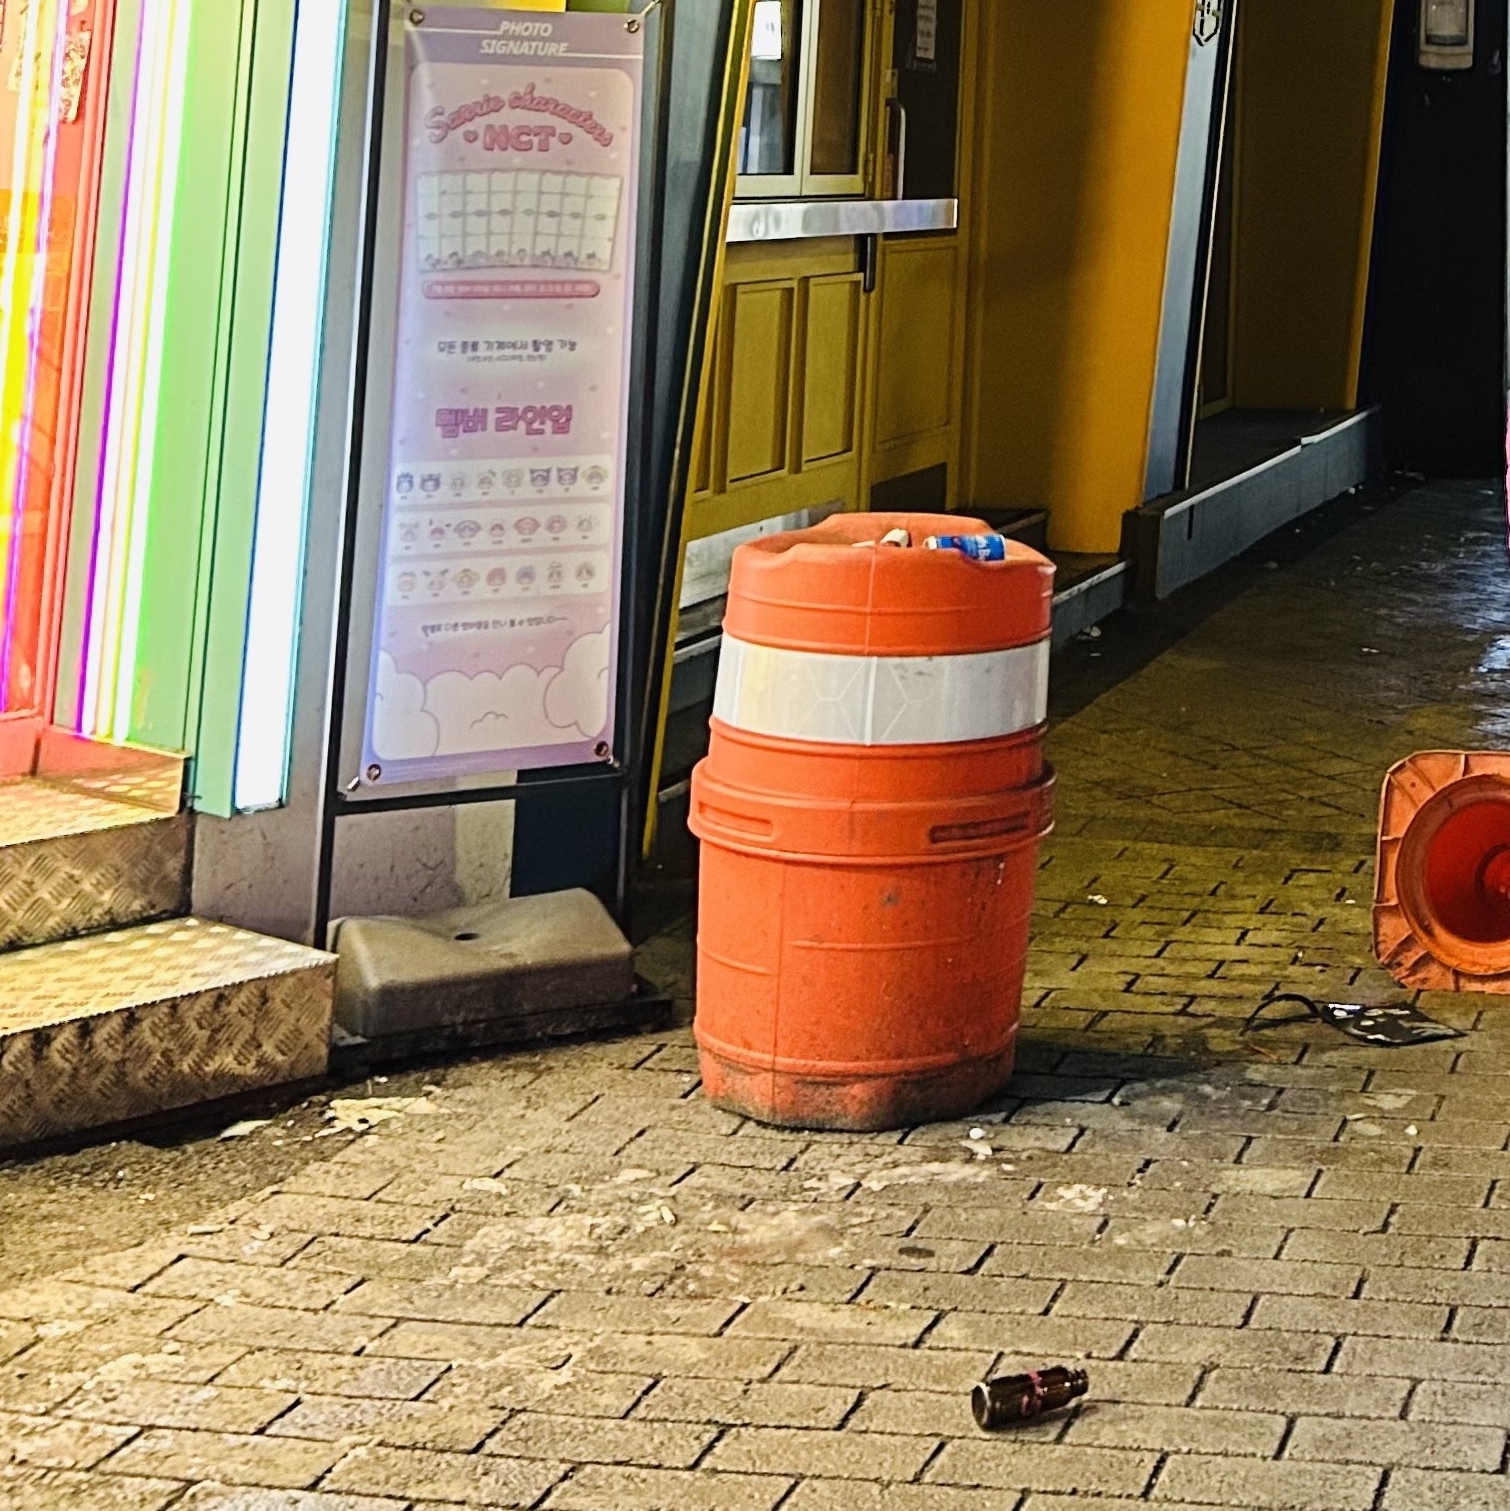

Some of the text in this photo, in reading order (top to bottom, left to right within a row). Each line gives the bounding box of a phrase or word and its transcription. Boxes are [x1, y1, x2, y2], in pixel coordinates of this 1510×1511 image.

[500, 21, 552, 36] PHOTO
[480, 40, 569, 56] SIGNATURE
[483, 124, 556, 152] NCT
[435, 404, 573, 439] 멤버 라인업
